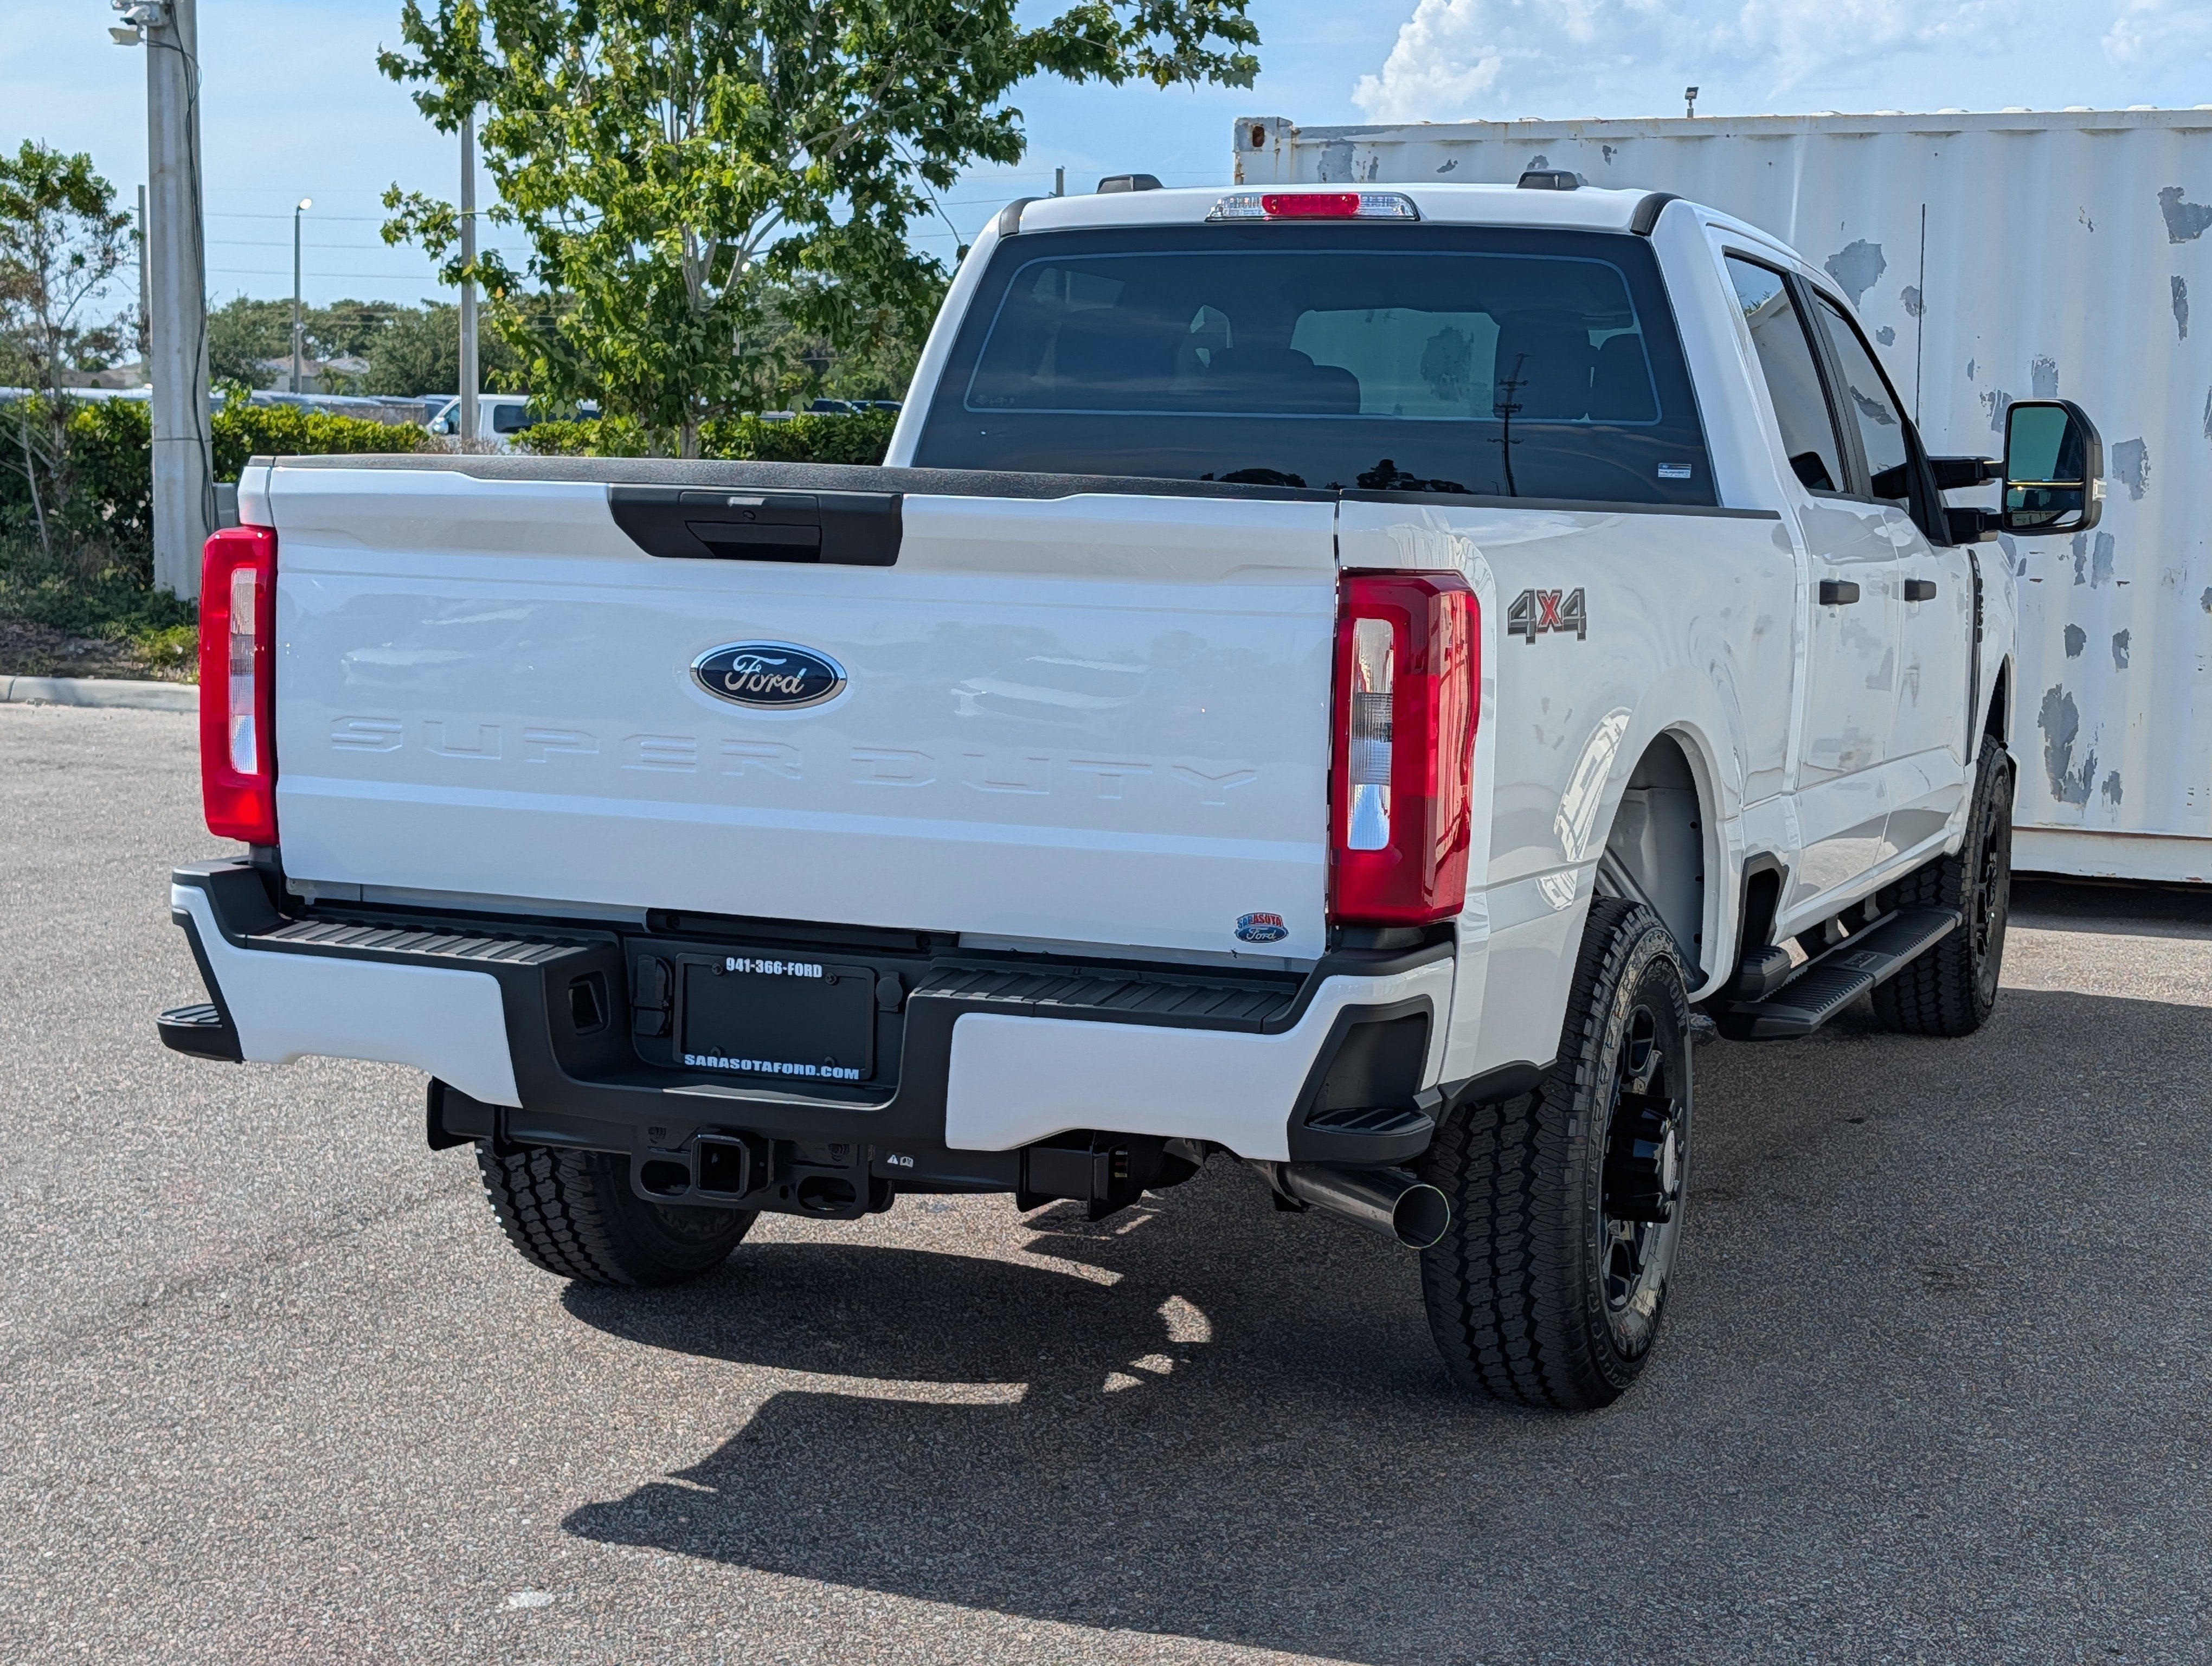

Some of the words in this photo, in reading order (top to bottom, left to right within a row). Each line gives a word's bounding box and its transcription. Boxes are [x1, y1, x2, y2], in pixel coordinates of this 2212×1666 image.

[724, 654, 807, 694] Ford
[331, 715, 801, 779] SUPER
[851, 746, 1257, 805] DUTY
[1246, 928, 1277, 940] Ford
[726, 957, 822, 978] 941-366-FORD
[684, 1054, 859, 1080] SARASOTAFORD.COM
